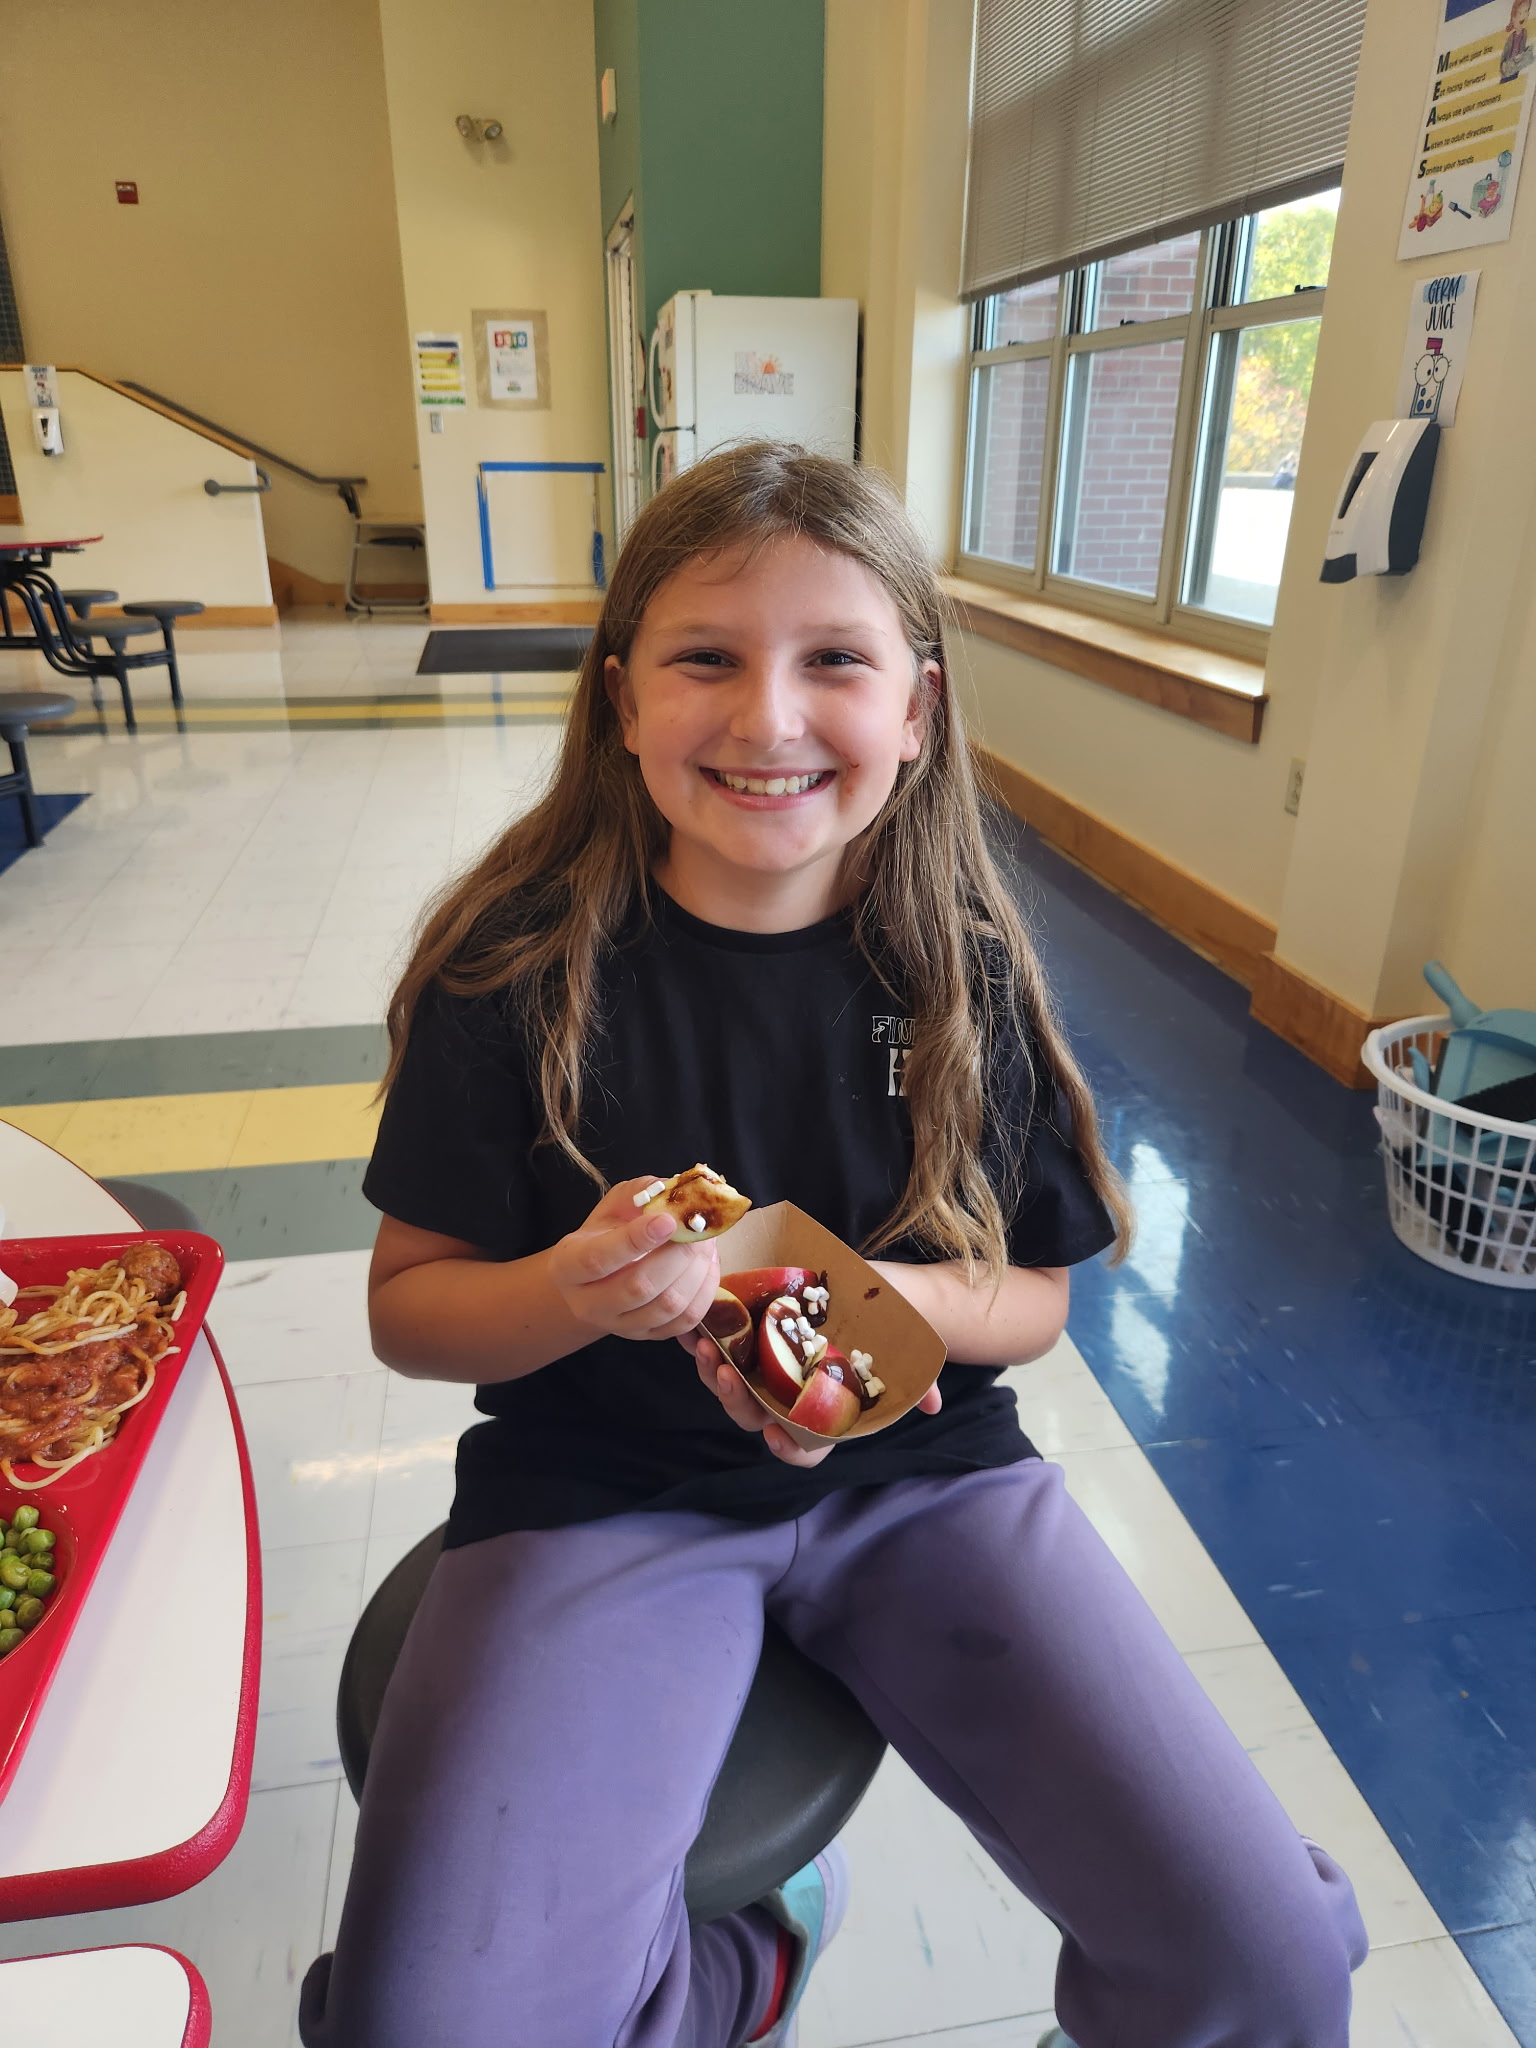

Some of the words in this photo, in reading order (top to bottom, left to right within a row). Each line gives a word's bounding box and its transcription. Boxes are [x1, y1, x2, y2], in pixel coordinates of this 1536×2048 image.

[1447, 83, 1462, 93] facing
[1464, 72, 1486, 87] forward
[1462, 103, 1475, 115] your
[1451, 133, 1465, 143] adult
[1466, 125, 1493, 138] directions
[1443, 162, 1456, 172] your
[1428, 275, 1462, 304] GERM
[1426, 303, 1455, 331] JUICE
